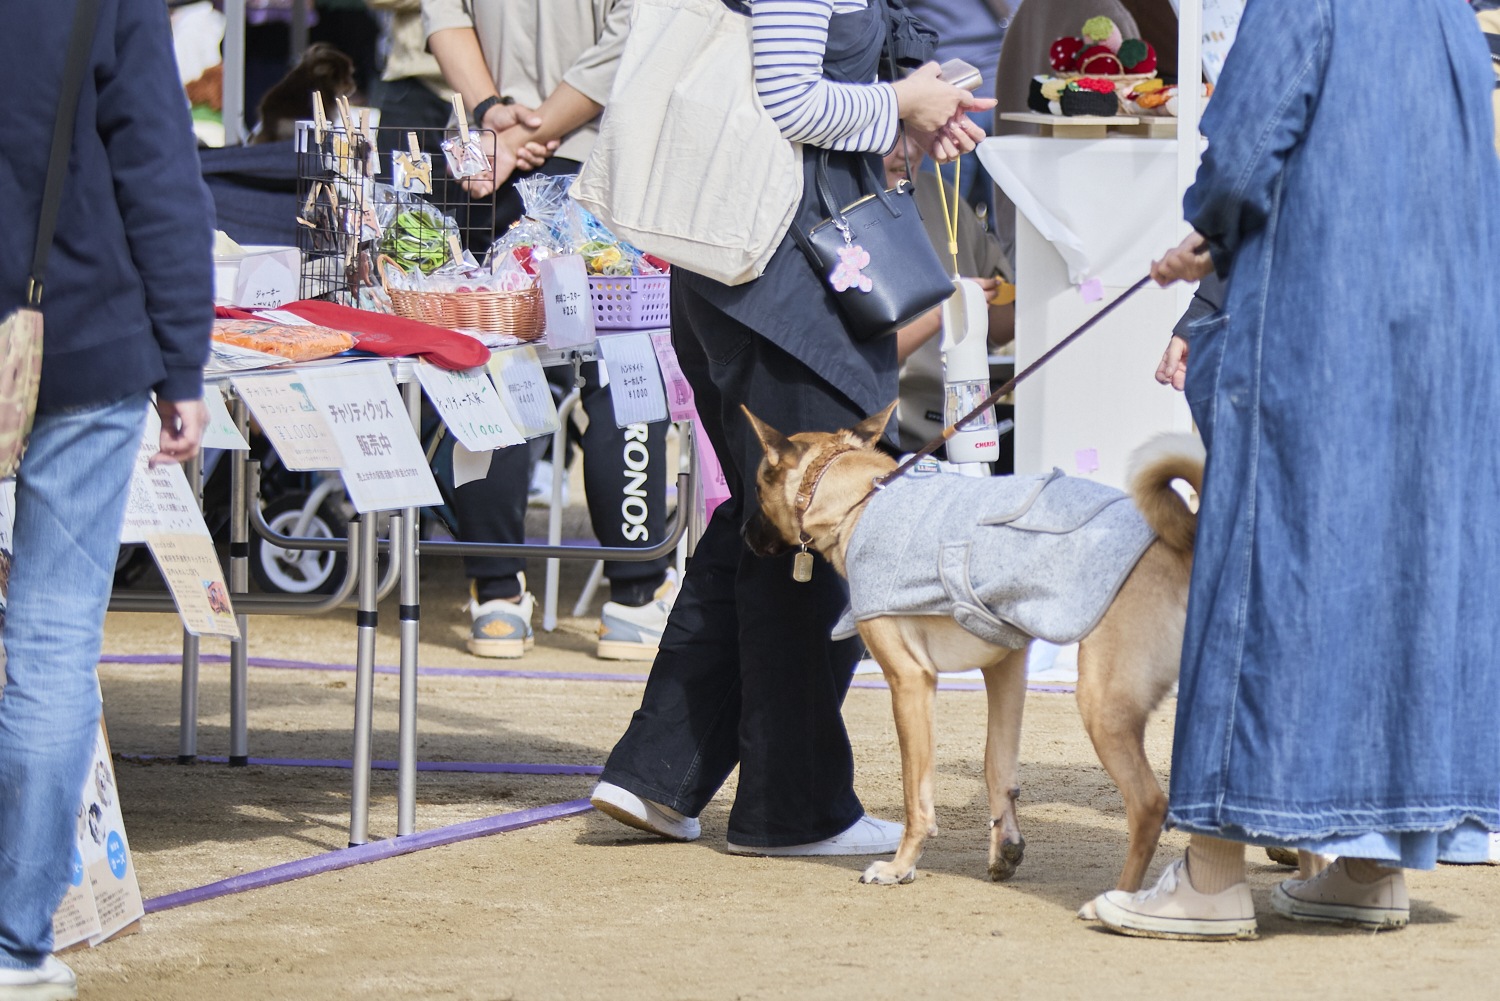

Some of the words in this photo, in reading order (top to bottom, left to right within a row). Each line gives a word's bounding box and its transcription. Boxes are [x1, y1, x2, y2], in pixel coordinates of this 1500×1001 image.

[562, 305, 577, 316] ¥250
[620, 362, 644, 374] ハンドメイド
[246, 386, 286, 398] チャリティー
[628, 388, 649, 399] ¥1000
[260, 404, 296, 415] サコッシュ
[328, 398, 394, 424] チャリティグッズ
[274, 423, 319, 441] ¥1,000
[356, 432, 393, 457] 販売中
